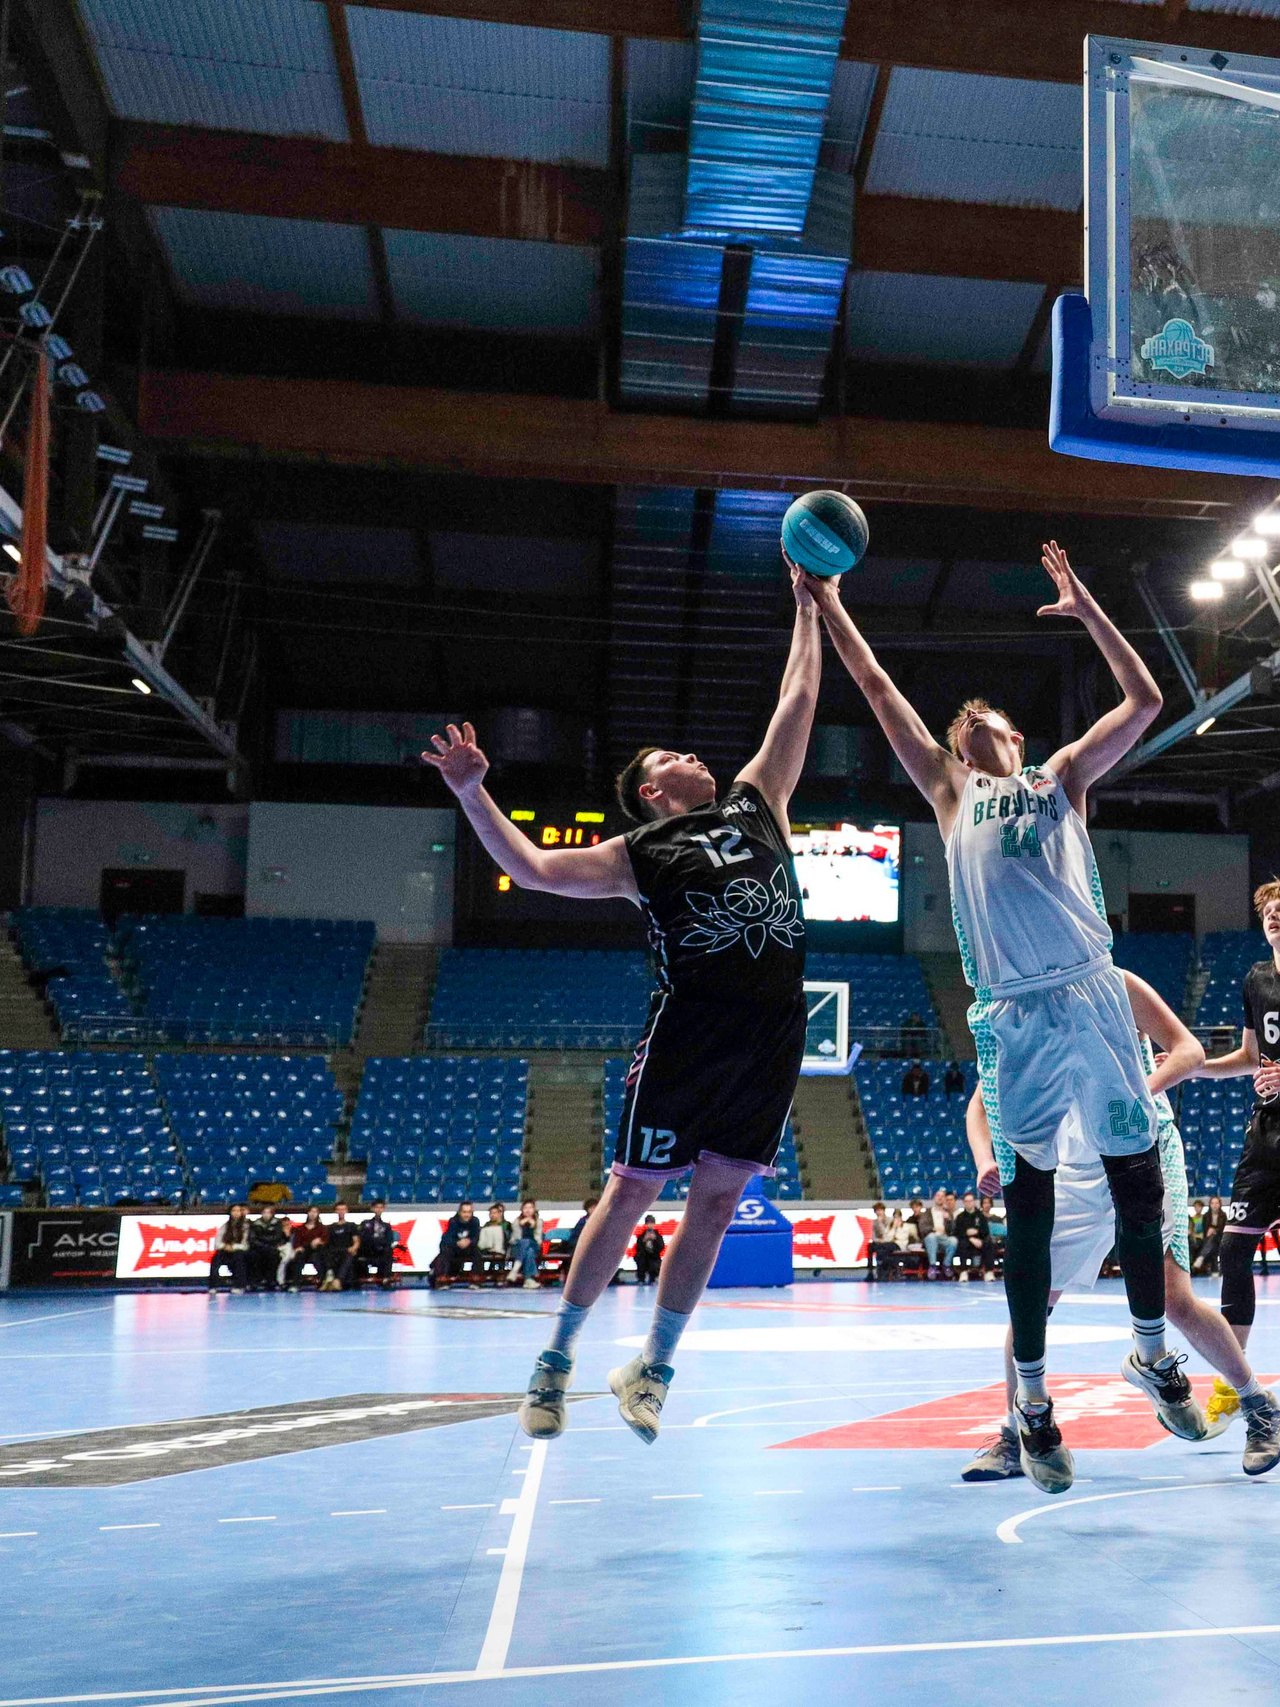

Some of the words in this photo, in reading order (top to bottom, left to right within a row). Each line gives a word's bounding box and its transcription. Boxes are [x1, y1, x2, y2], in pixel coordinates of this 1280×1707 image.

[973, 788, 1059, 827] BEAVERS
[542, 827, 583, 844] 0:11
[689, 824, 755, 868] 12
[1000, 821, 1042, 858] 24
[1107, 1097, 1149, 1136] 24
[640, 1126, 677, 1164] 12
[53, 1232, 118, 1247] АКС
[0, 1400, 453, 1476] axioma30.r
